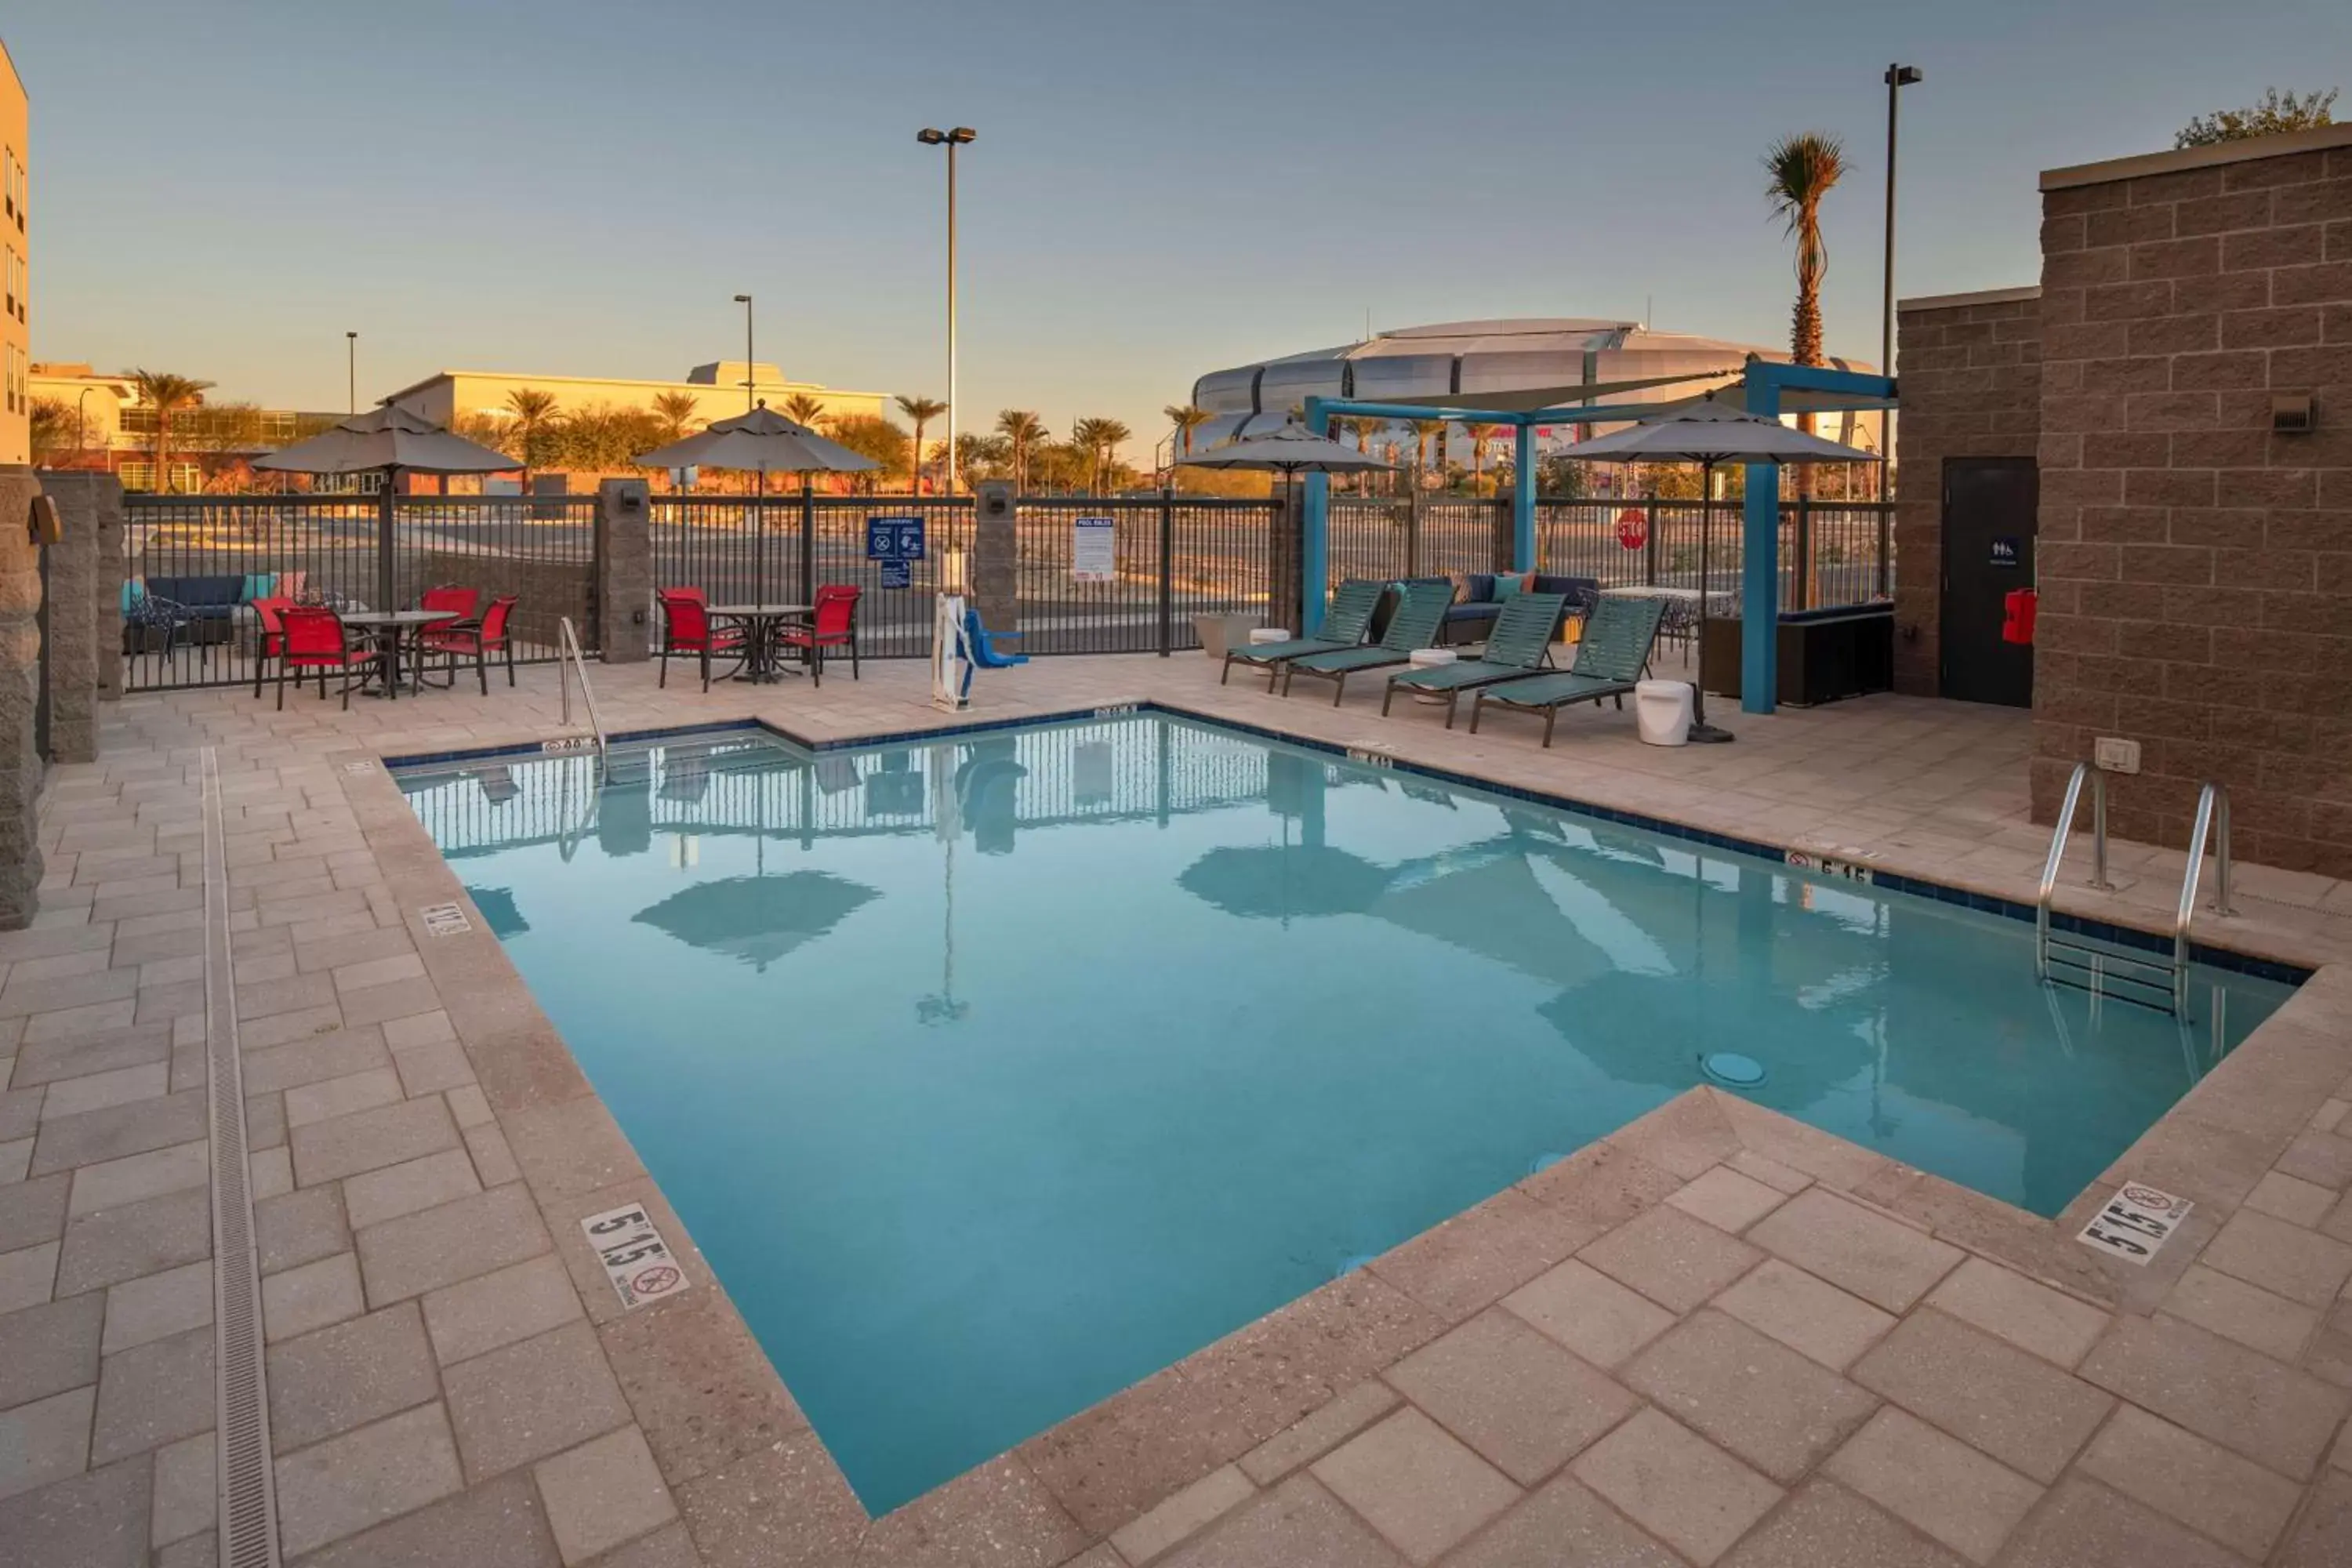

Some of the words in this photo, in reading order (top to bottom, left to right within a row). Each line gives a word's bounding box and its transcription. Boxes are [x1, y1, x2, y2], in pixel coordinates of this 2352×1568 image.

[1619, 521, 1646, 537] STOP
[590, 1211, 644, 1234] 5
[2085, 1228, 2148, 1255] 5
